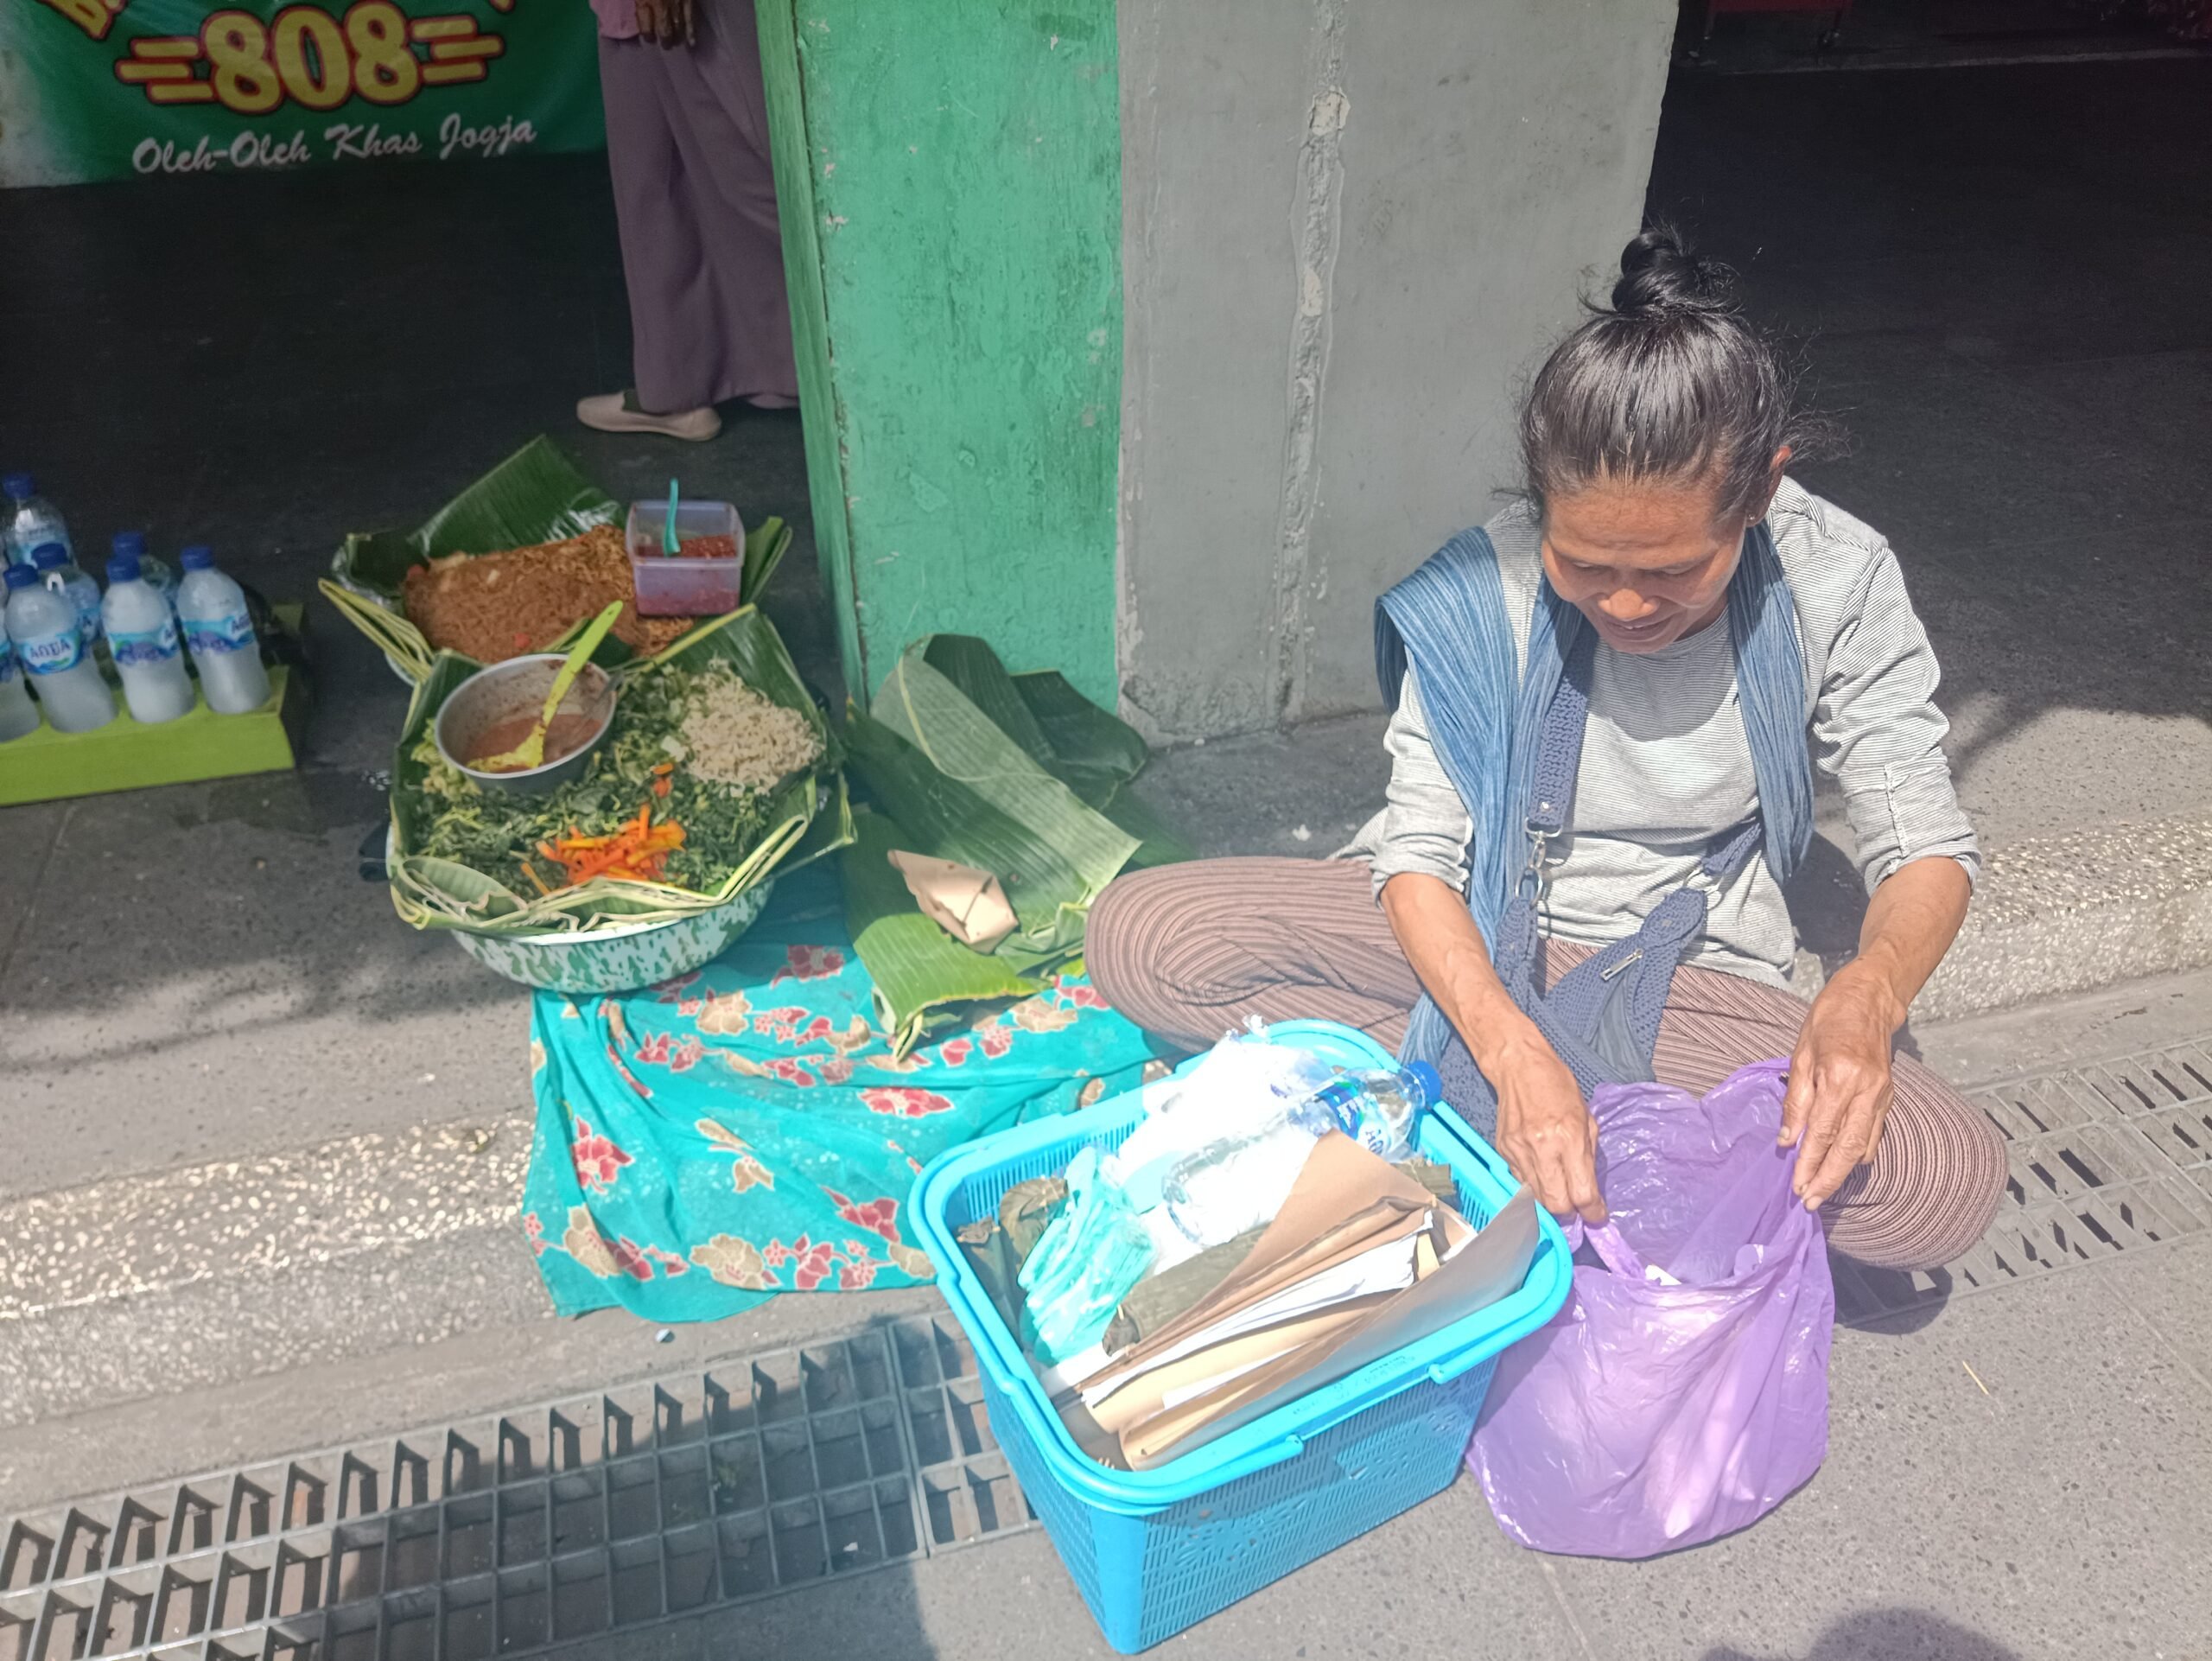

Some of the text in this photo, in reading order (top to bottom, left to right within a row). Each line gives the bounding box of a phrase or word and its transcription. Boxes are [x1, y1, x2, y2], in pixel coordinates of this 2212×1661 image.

[201, 2, 423, 114] 808
[132, 113, 537, 174] Oleh-Oleh Khas Jogja
[29, 638, 72, 659] AQUA
